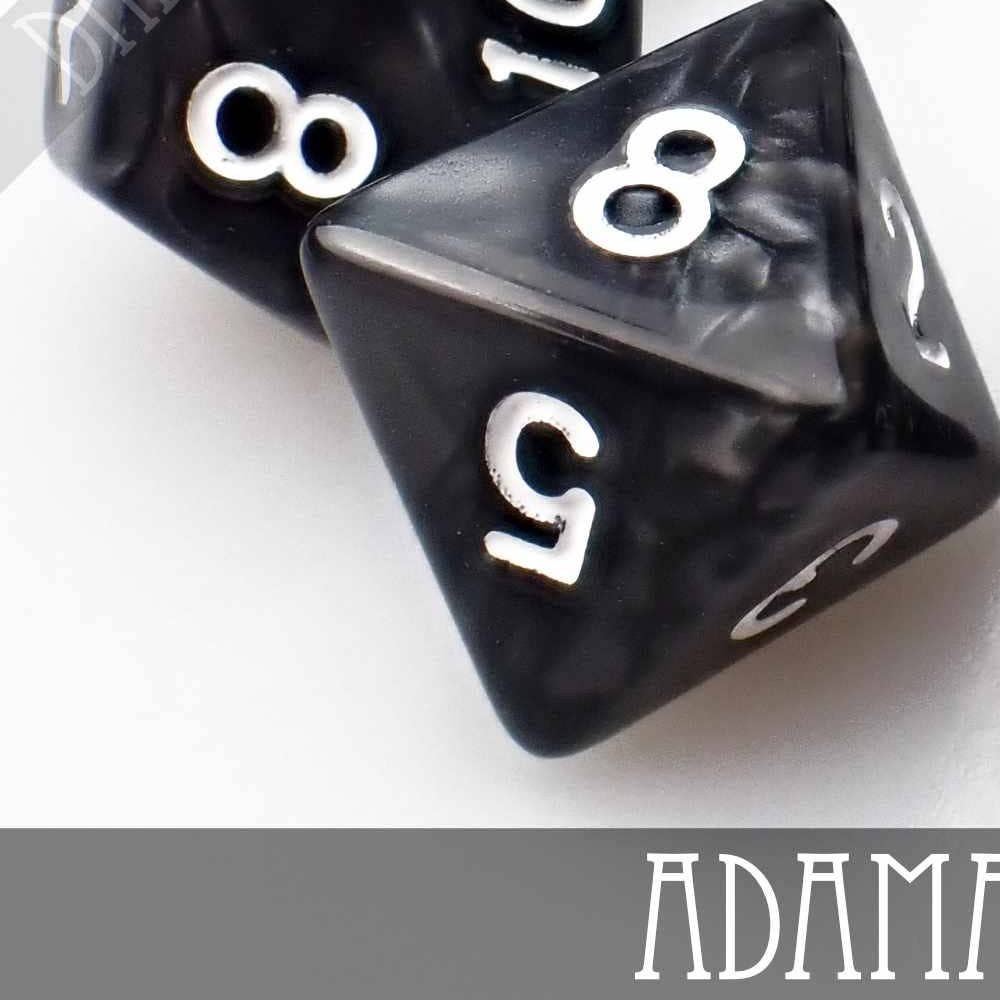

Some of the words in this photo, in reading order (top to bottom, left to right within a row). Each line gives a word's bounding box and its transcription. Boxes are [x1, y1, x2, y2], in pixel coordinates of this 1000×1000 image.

[187, 62, 378, 199] 8
[570, 106, 748, 258] 8
[484, 391, 600, 586] 5
[731, 519, 898, 640] 3
